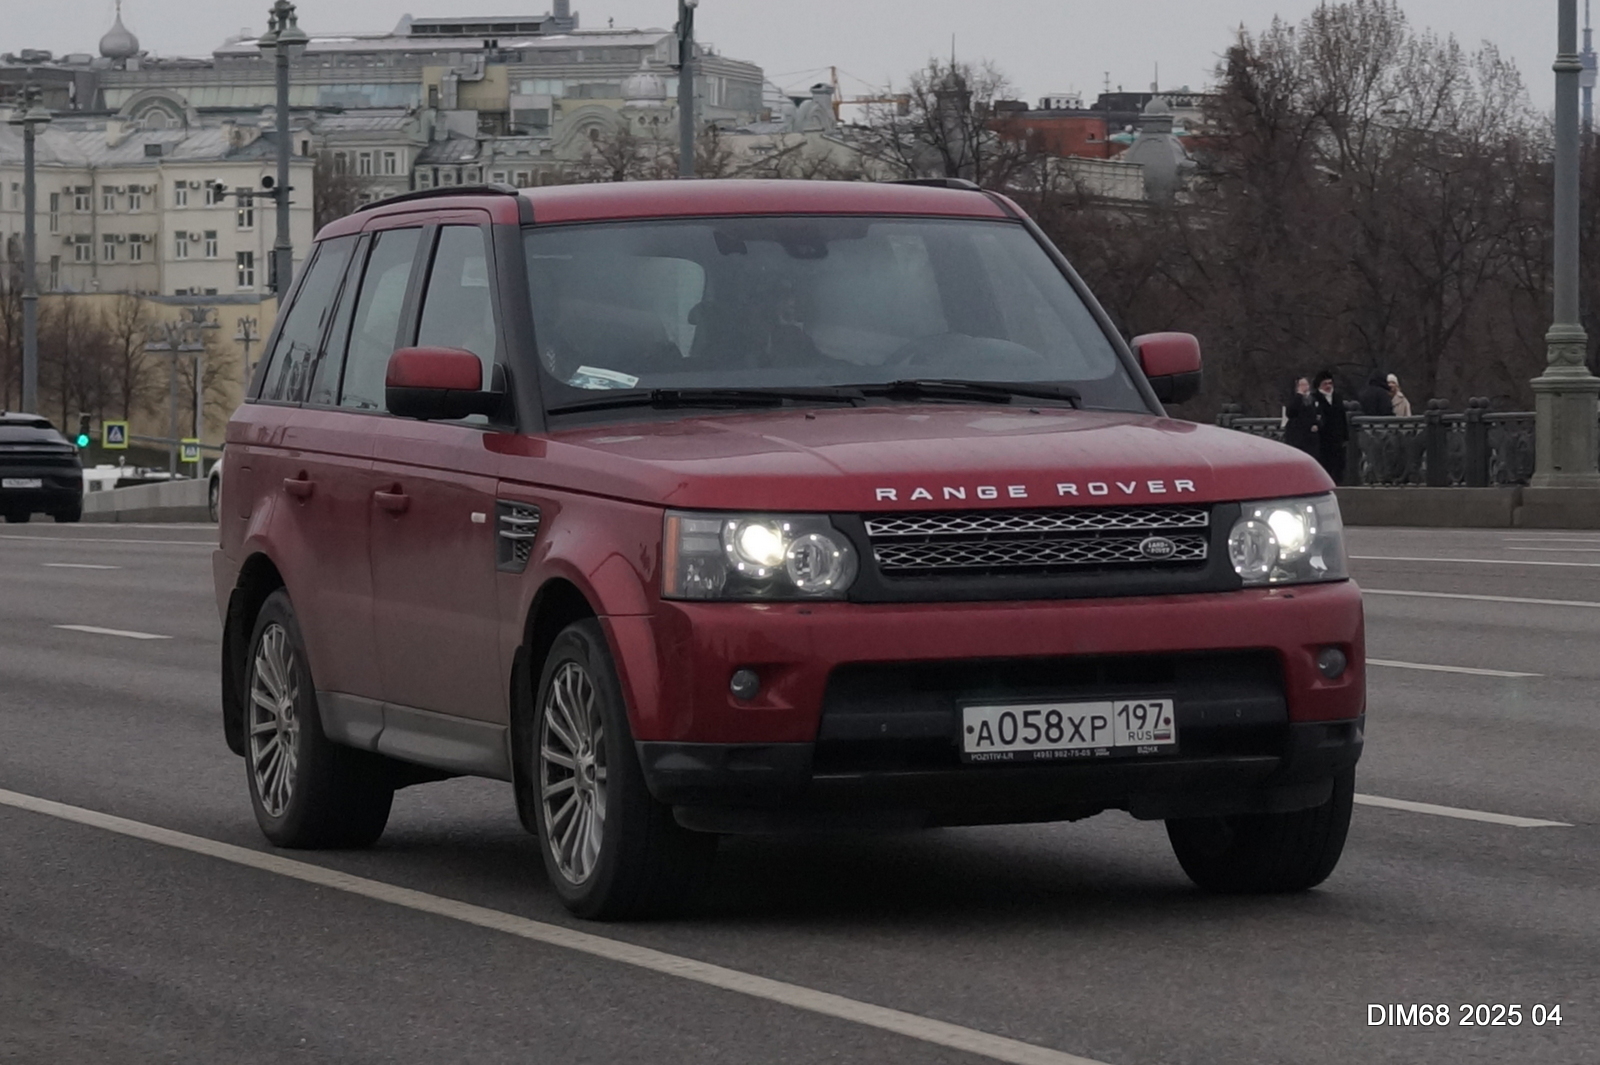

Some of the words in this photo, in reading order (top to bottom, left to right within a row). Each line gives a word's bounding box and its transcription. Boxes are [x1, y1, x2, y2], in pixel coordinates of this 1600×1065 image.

[876, 485, 1028, 501] RANGE
[1057, 479, 1196, 496] ROVER
[976, 708, 1107, 747] А058ХР
[1117, 703, 1163, 731] 197
[1128, 729, 1152, 742] RUS
